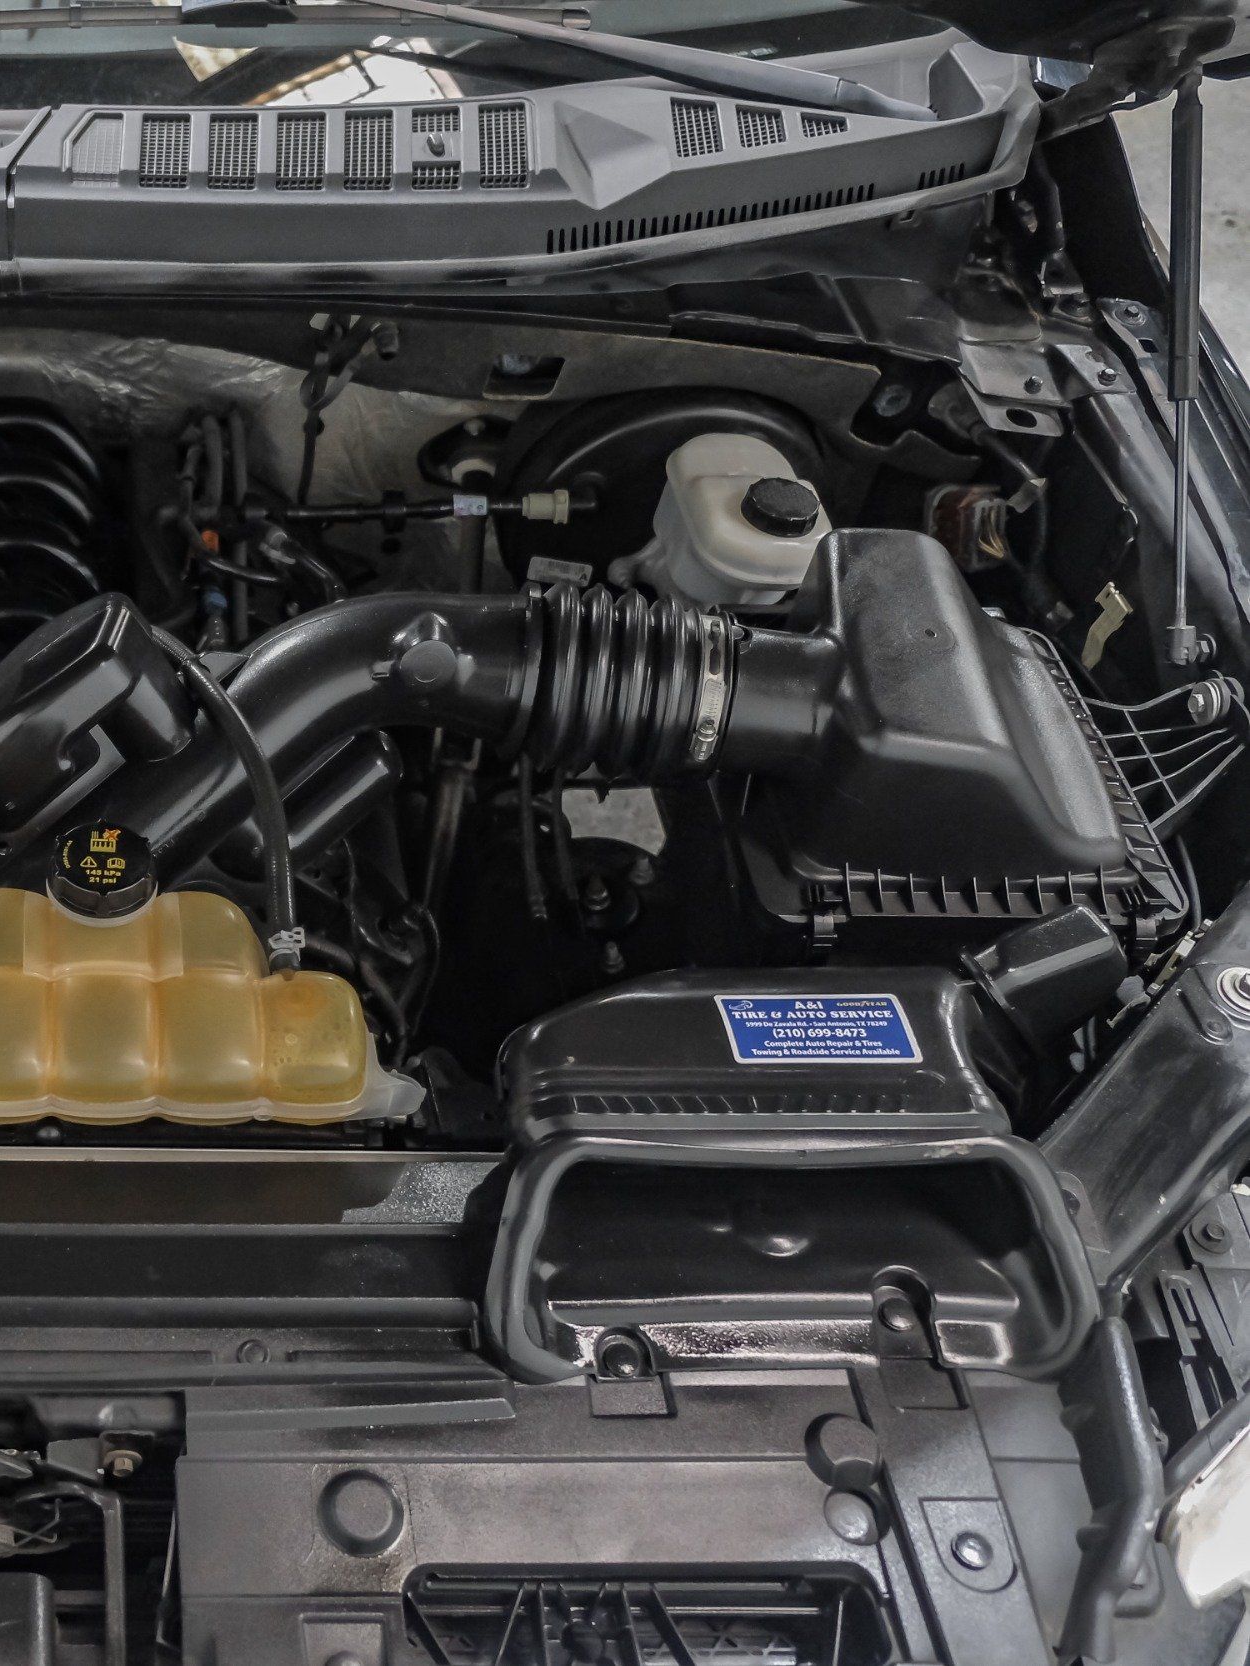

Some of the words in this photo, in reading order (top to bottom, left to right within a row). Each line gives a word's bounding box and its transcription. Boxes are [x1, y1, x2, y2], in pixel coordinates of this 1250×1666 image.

[794, 1001, 824, 1010] A&I
[732, 1011, 768, 1019] TIRE
[770, 1011, 782, 1019] &
[786, 1011, 827, 1019] AUTO
[830, 1010, 894, 1019] SERVICE
[773, 1029, 806, 1038] (210)
[808, 1029, 867, 1038] 699-8473
[764, 1040, 804, 1048] Complete
[826, 1040, 853, 1048] Repair
